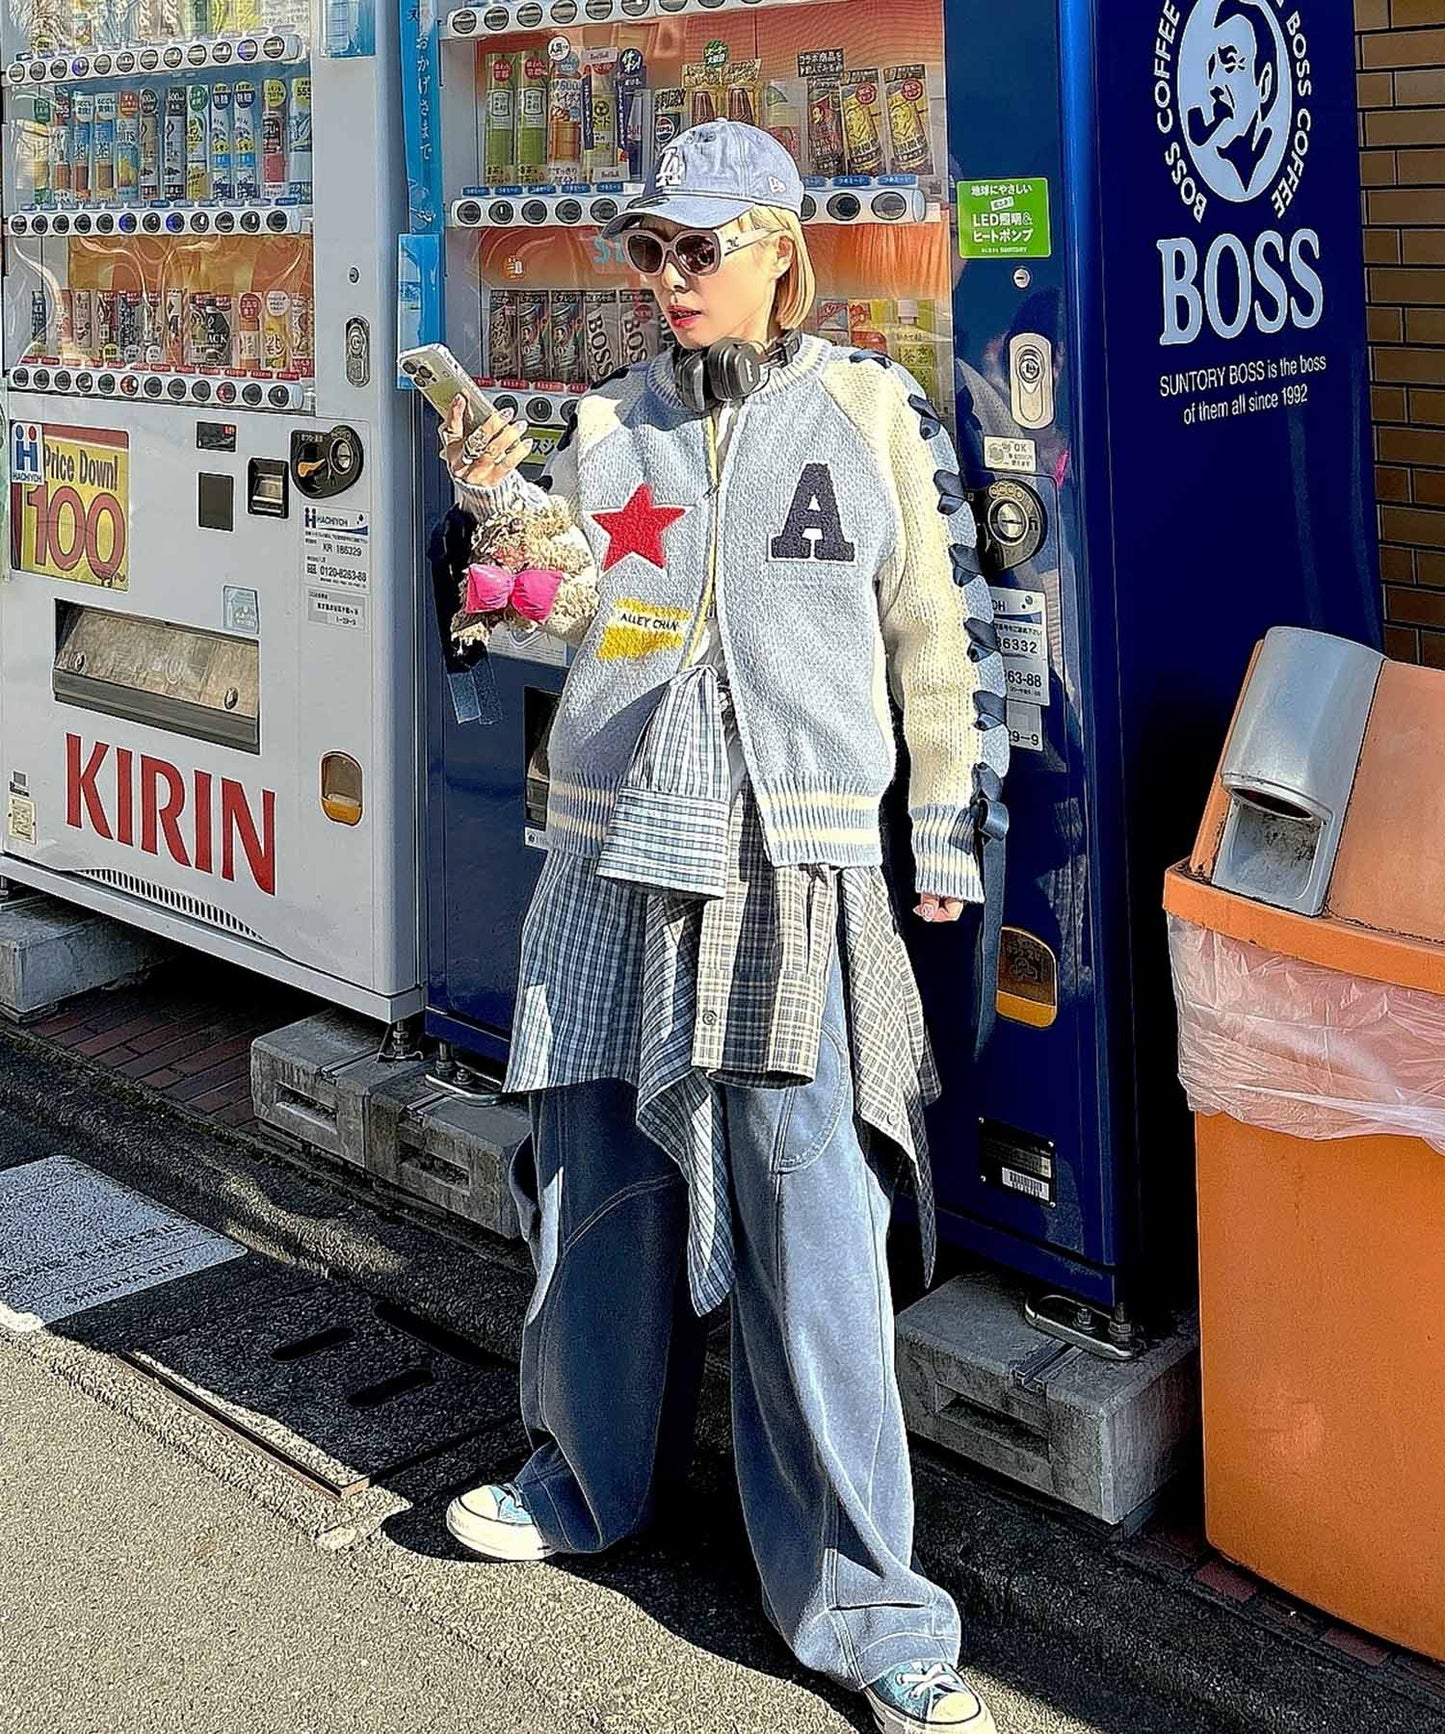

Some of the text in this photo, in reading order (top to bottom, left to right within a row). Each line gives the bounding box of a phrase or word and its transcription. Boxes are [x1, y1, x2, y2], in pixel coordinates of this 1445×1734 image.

[1154, 0, 1180, 133] COFFEE
[415, 34, 432, 161] おかげさまで
[1271, 11, 1312, 218] BOSS COFFEE
[971, 184, 1033, 196] 地球にやさしい
[1164, 142, 1207, 223] BOSS
[973, 212, 1033, 227] LED照明&
[973, 228, 1034, 243] ヒートポンプ
[1156, 228, 1323, 345] BOSS
[587, 316, 614, 377] BOSS
[624, 319, 648, 365] BOS
[1159, 355, 1327, 397] SUNTORY BOSS is the boss
[1183, 383, 1308, 425] of them all since 1992
[44, 443, 119, 491] Price Down!
[1014, 443, 1026, 452] OK
[27, 480, 125, 582] 100
[767, 461, 856, 564] A
[323, 543, 332, 553] KR
[320, 565, 367, 582] 0120-8263-88
[620, 613, 651, 628] ALLEY
[1004, 670, 1042, 688] 63-88
[1009, 730, 1039, 746] 9-9
[66, 732, 275, 896] KIRIN
